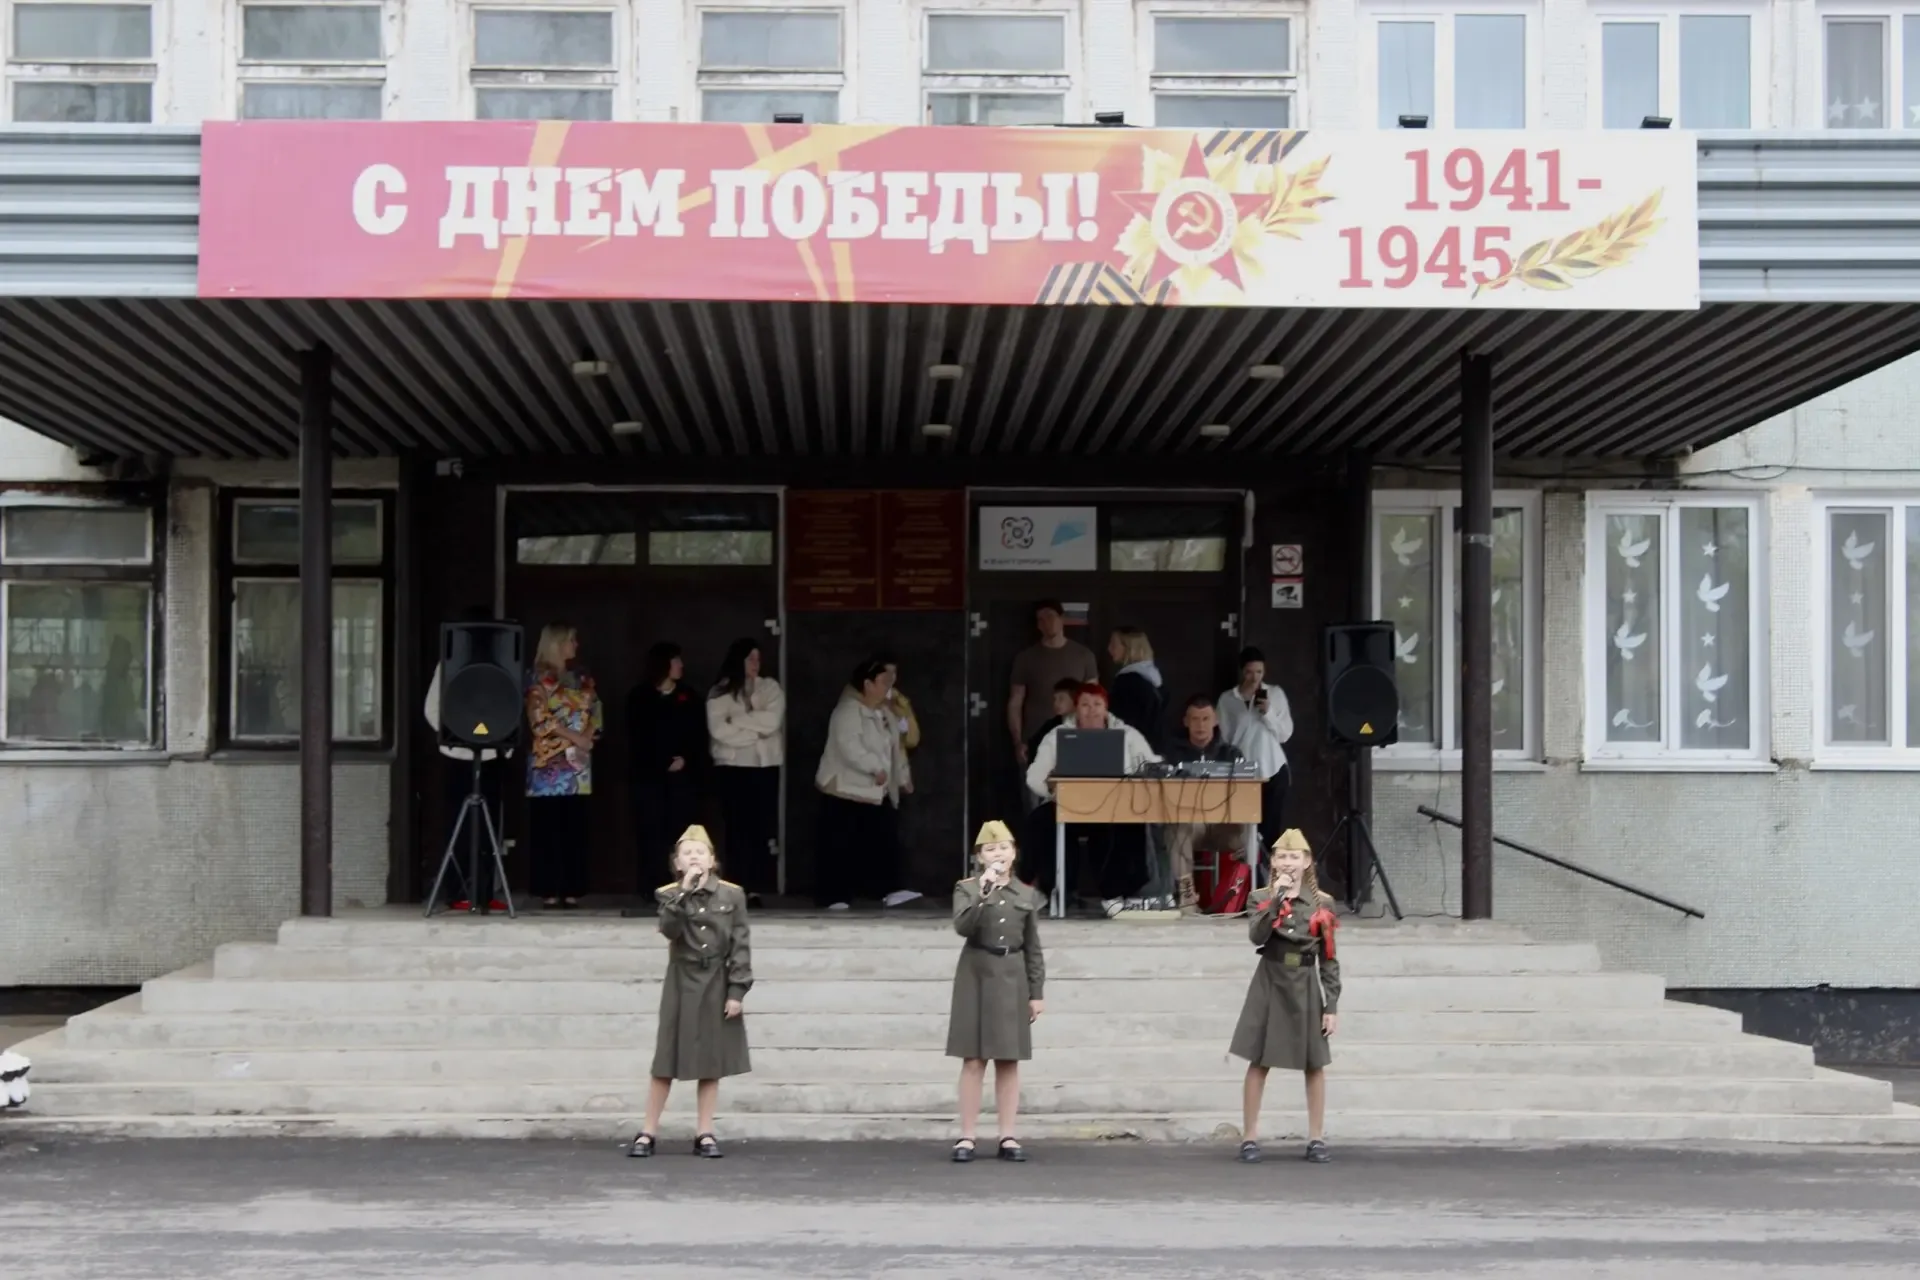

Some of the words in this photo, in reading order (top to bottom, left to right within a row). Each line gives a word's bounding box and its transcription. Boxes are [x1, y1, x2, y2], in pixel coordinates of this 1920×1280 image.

[352, 163, 408, 235] С
[438, 165, 686, 249] ДНЕМ
[708, 168, 1100, 254] ПОБЕДЫ!
[1404, 147, 1602, 212] 1941-
[1338, 225, 1515, 290] 1945
